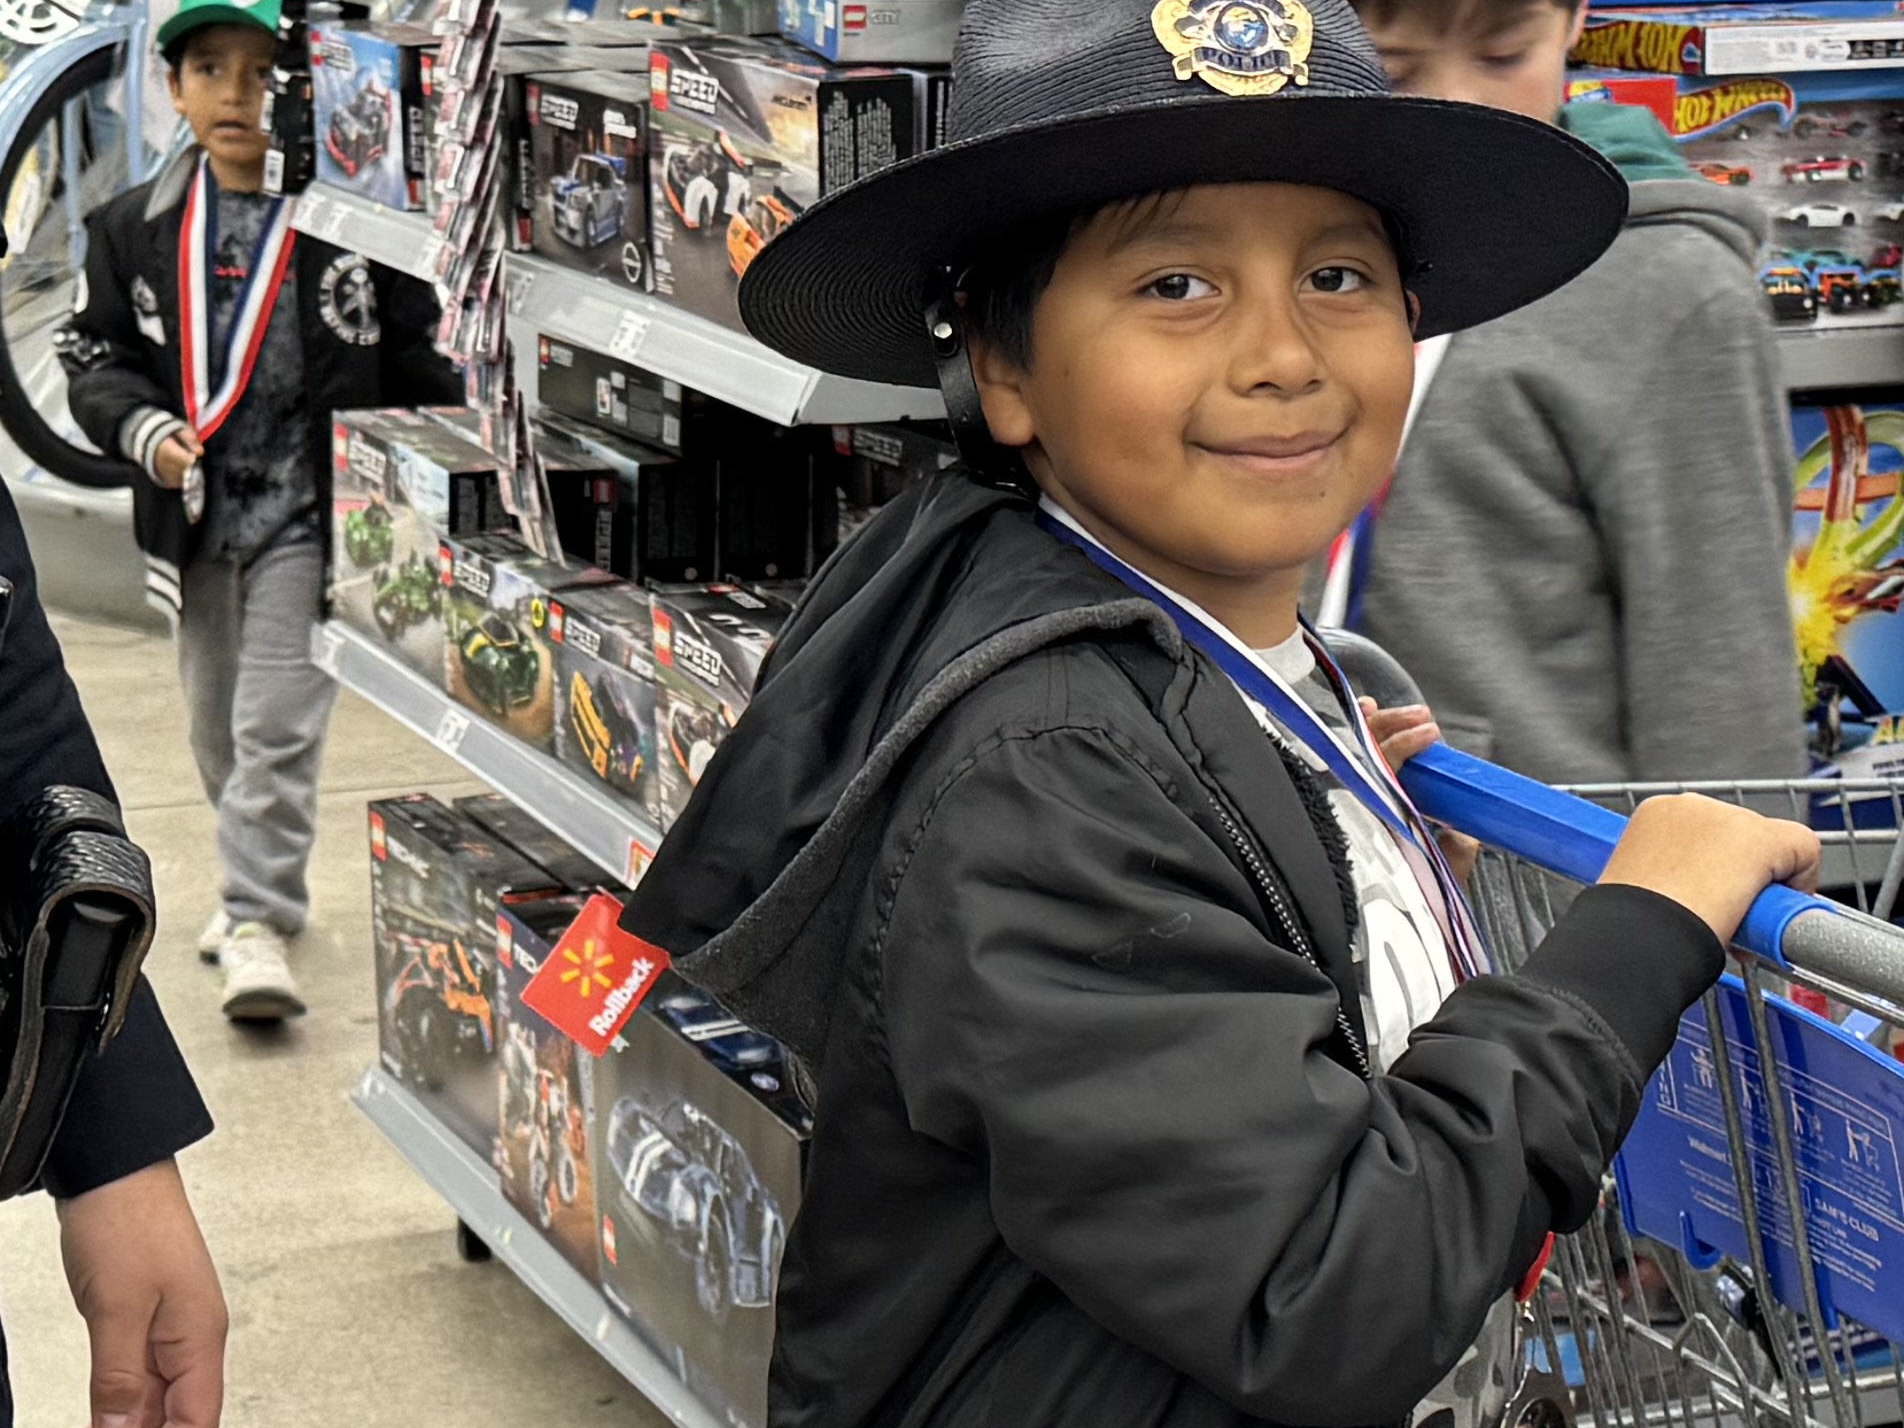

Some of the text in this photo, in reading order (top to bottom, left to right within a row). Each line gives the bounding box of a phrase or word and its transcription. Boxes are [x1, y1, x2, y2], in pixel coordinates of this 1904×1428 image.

[670, 72, 720, 102] SPEED
[1675, 93, 1711, 134] HOT
[589, 957, 656, 1037] Rollback
